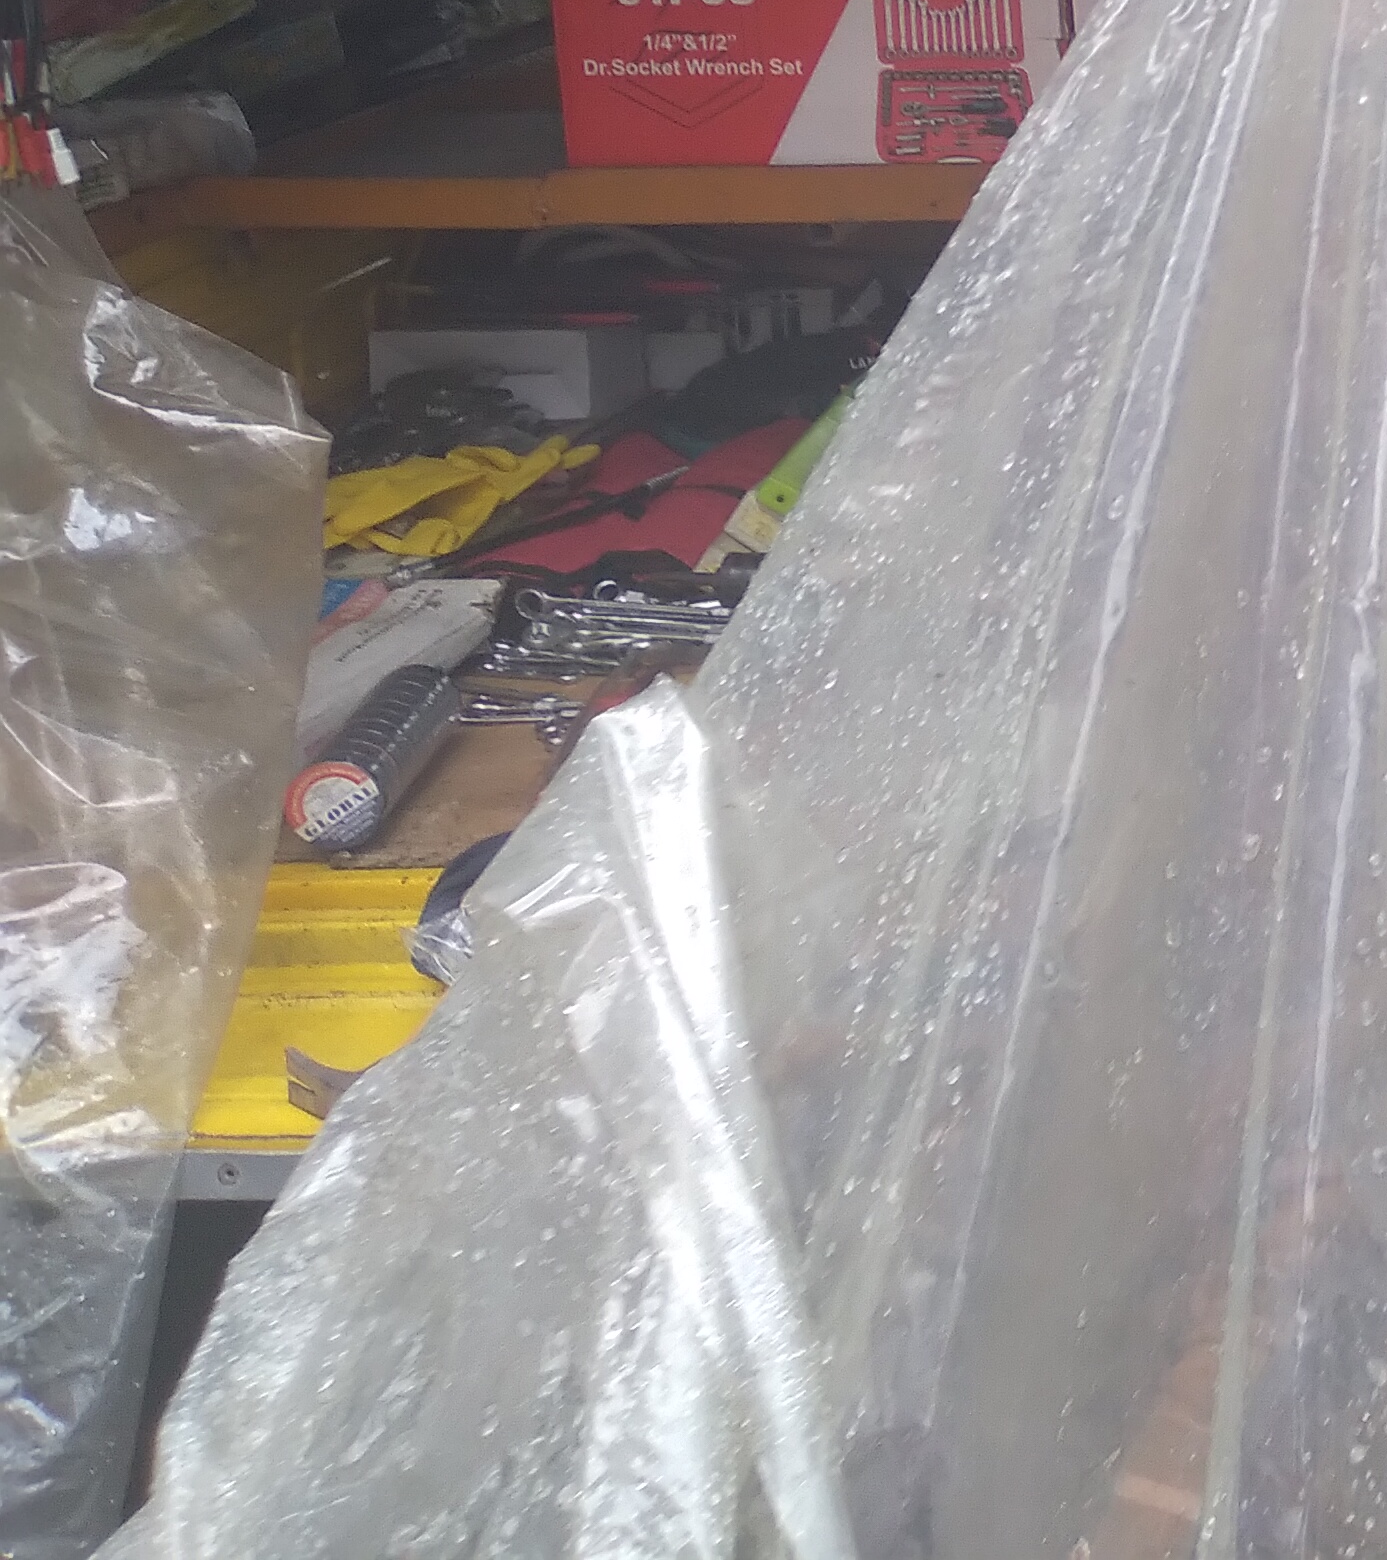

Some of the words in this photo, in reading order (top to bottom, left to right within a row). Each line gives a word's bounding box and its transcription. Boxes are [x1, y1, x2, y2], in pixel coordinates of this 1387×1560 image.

[583, 56, 681, 77] Dr.Socket
[684, 57, 764, 77] Wrench
[768, 56, 804, 77] Set
[304, 786, 373, 839] GLOBAL
